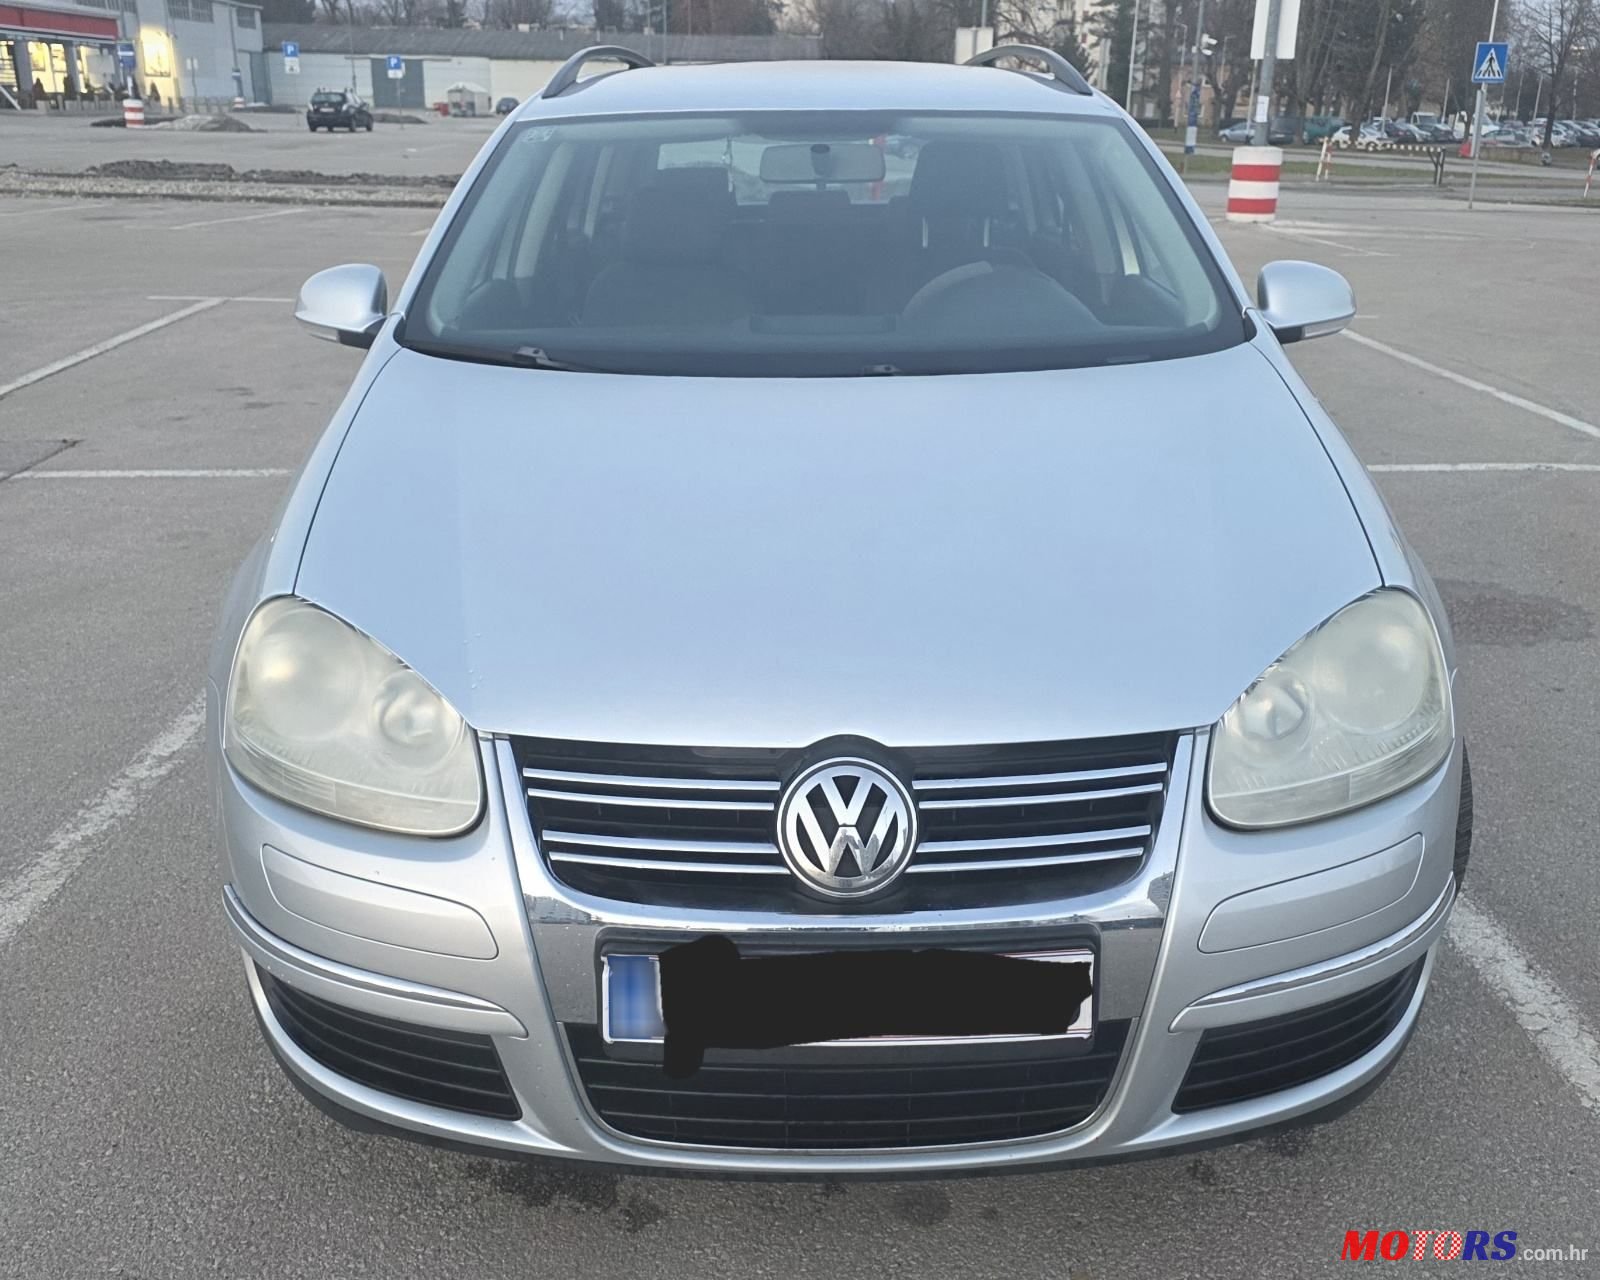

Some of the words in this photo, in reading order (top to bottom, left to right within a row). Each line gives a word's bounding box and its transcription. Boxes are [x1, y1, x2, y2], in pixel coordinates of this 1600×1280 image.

[287, 45, 295, 55] P
[390, 57, 398, 68] P
[787, 766, 908, 888] VW
